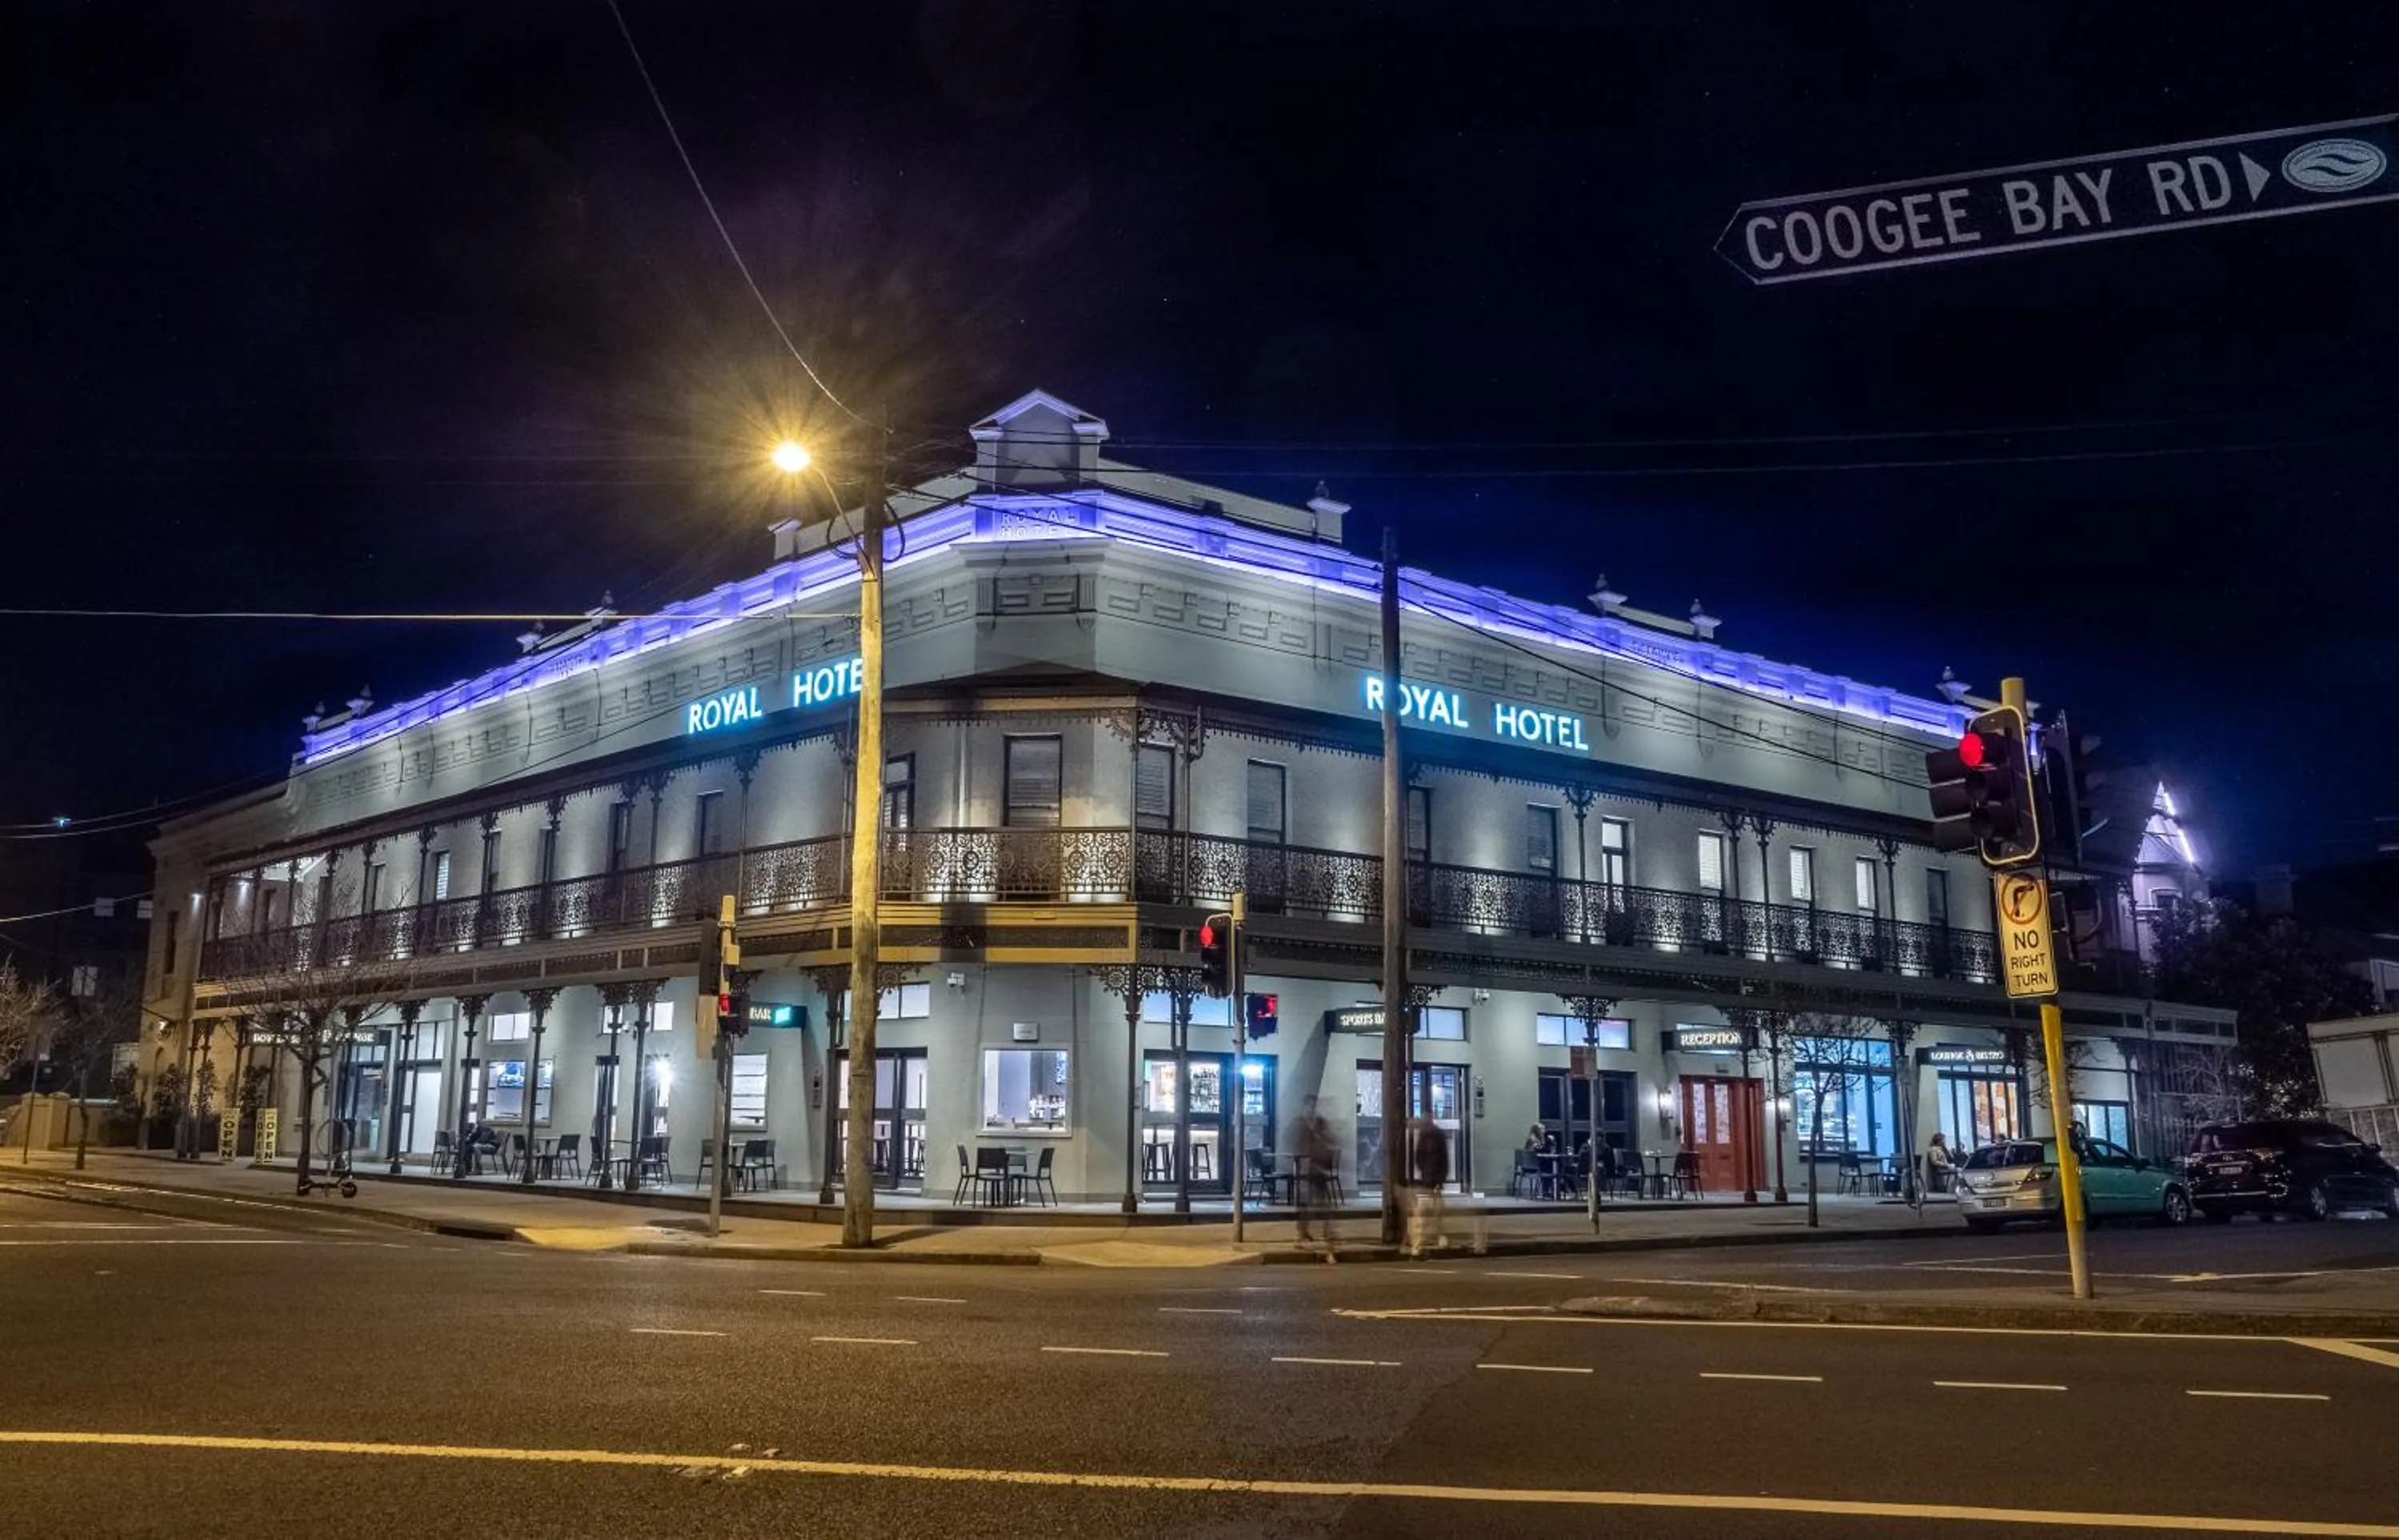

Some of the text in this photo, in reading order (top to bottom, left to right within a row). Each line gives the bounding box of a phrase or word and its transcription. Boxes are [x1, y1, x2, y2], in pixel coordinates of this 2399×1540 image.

[1745, 156, 2233, 270] COOGEE BAY RD
[1002, 509, 1076, 525] ROYAL
[689, 658, 863, 734] ROYAL HOTE
[1495, 703, 1589, 751] HOTEL
[2014, 930, 2039, 950] NO
[2011, 953, 2046, 970] RIGHT
[2014, 972, 2048, 987] TURN
[1681, 1031, 1742, 1046] RECEPTION
[222, 1121, 234, 1158] OPEN
[265, 1122, 274, 1159] OPEN
